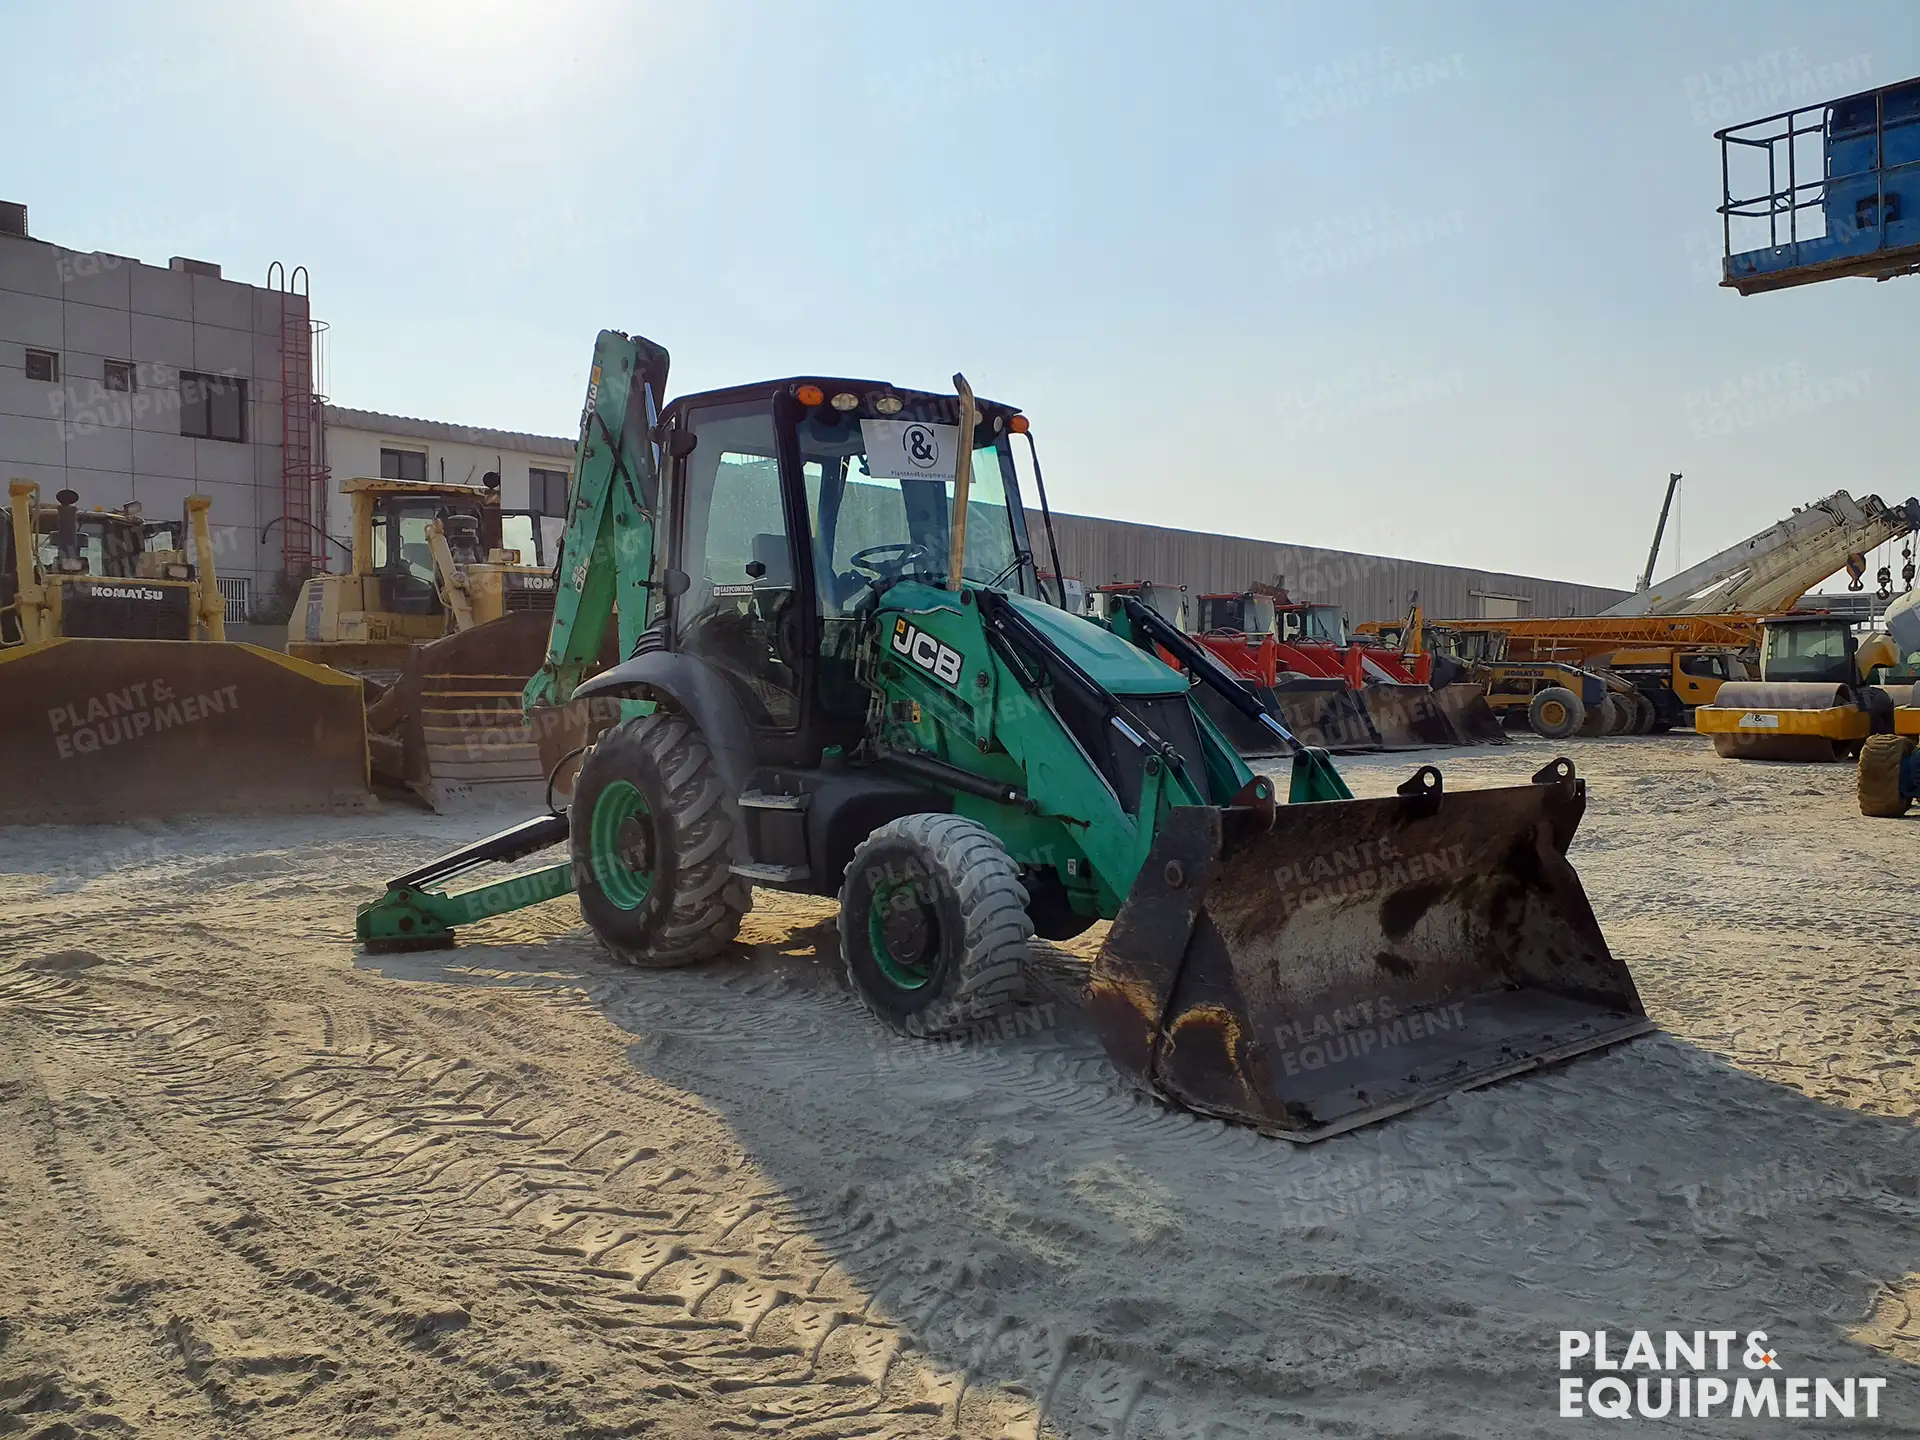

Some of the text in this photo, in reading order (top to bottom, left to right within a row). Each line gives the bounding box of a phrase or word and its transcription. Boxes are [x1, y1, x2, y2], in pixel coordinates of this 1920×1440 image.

[890, 470, 956, 479] PlantAndEquipment.co
[523, 577, 556, 589] KOM
[720, 585, 753, 593] EASYCONTROL
[91, 586, 163, 600] KOMATSU
[893, 625, 962, 684] JCB
